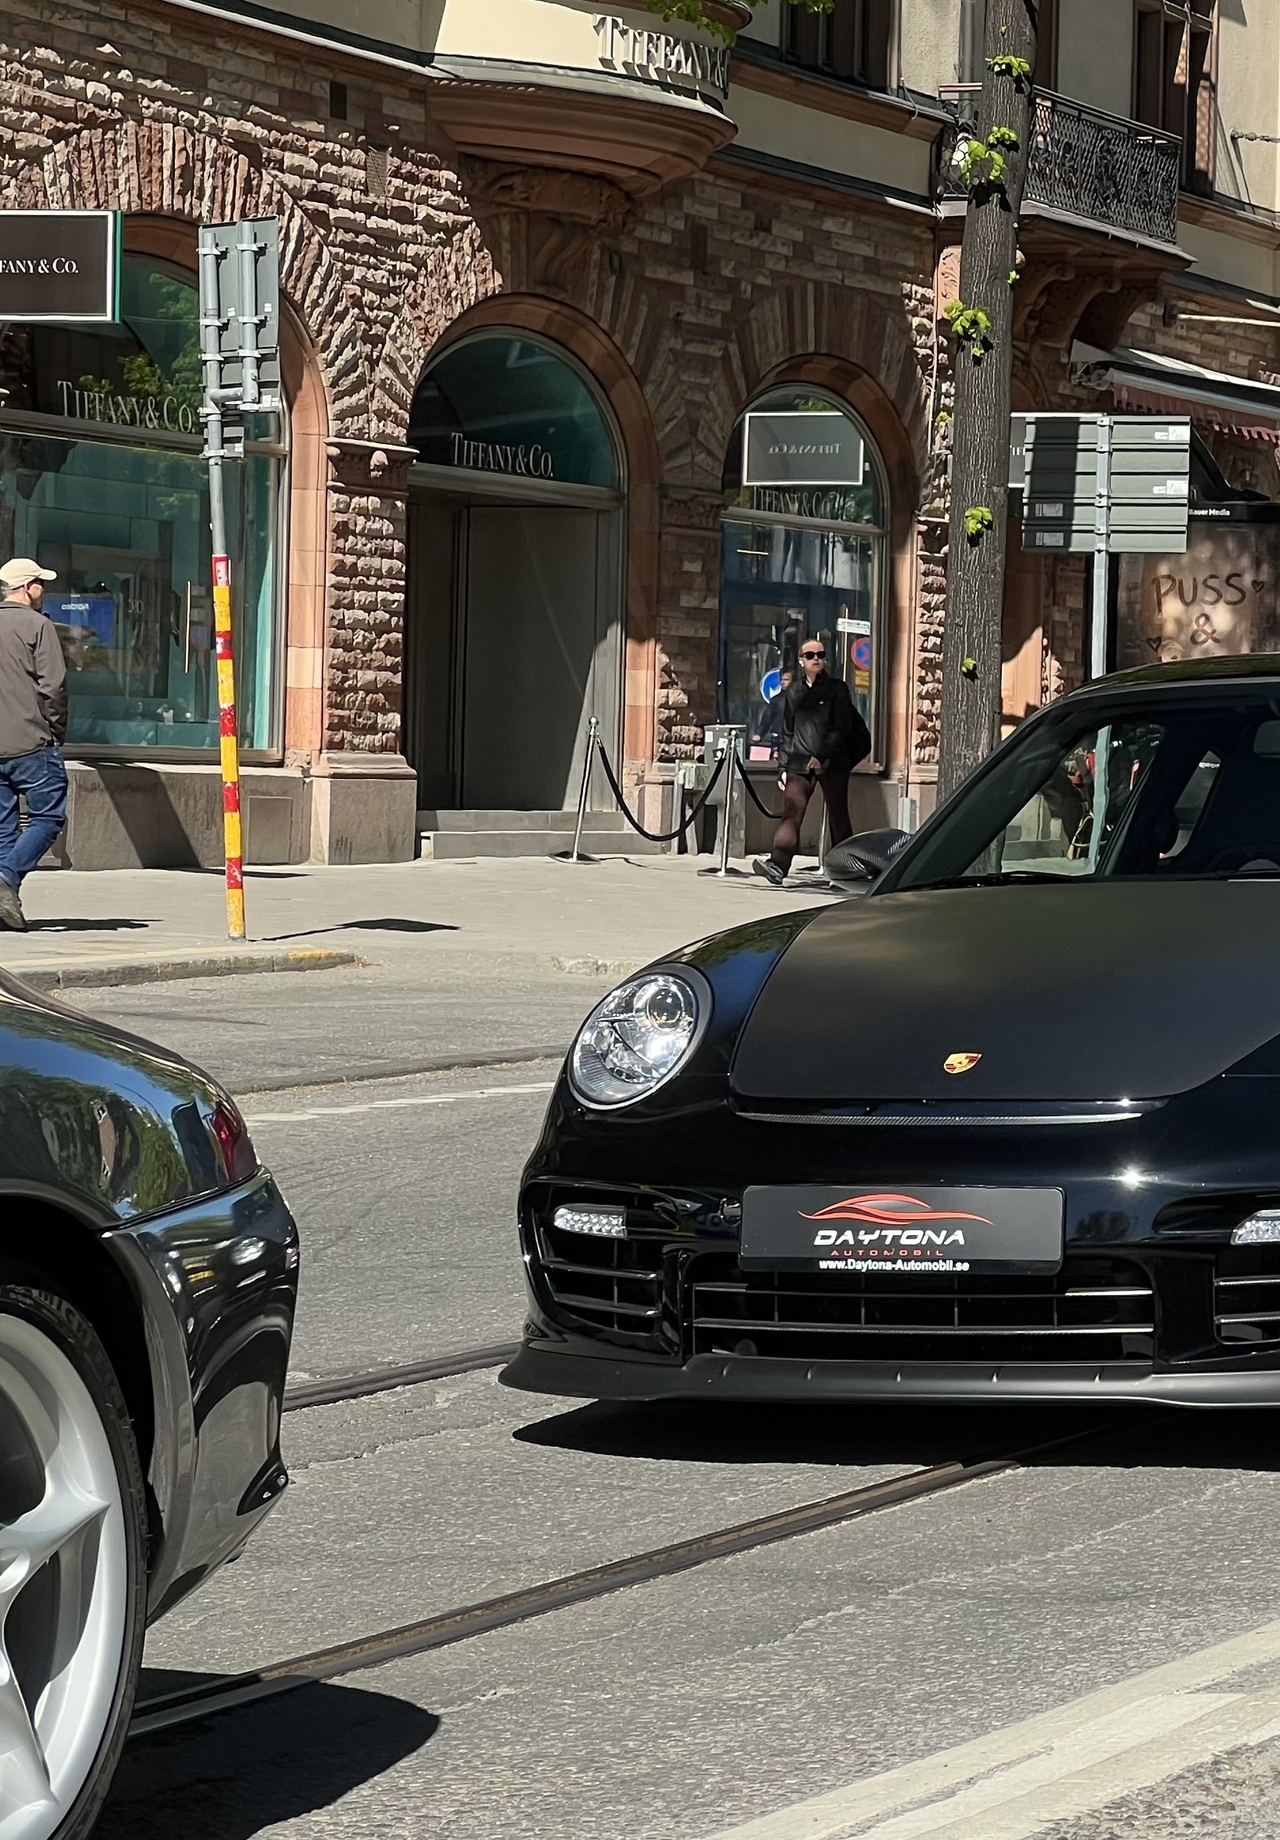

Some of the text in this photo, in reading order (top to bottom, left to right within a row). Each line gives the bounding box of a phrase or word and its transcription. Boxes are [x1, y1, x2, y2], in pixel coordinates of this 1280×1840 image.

[1208, 508, 1230, 516] Media
[1151, 573, 1247, 615] PUSS
[1190, 613, 1221, 645] &
[814, 1229, 966, 1246] DAYTONA
[830, 1249, 944, 1257] AUTOMOBIL
[818, 1259, 970, 1273] www.Daytona-Automobil.se
